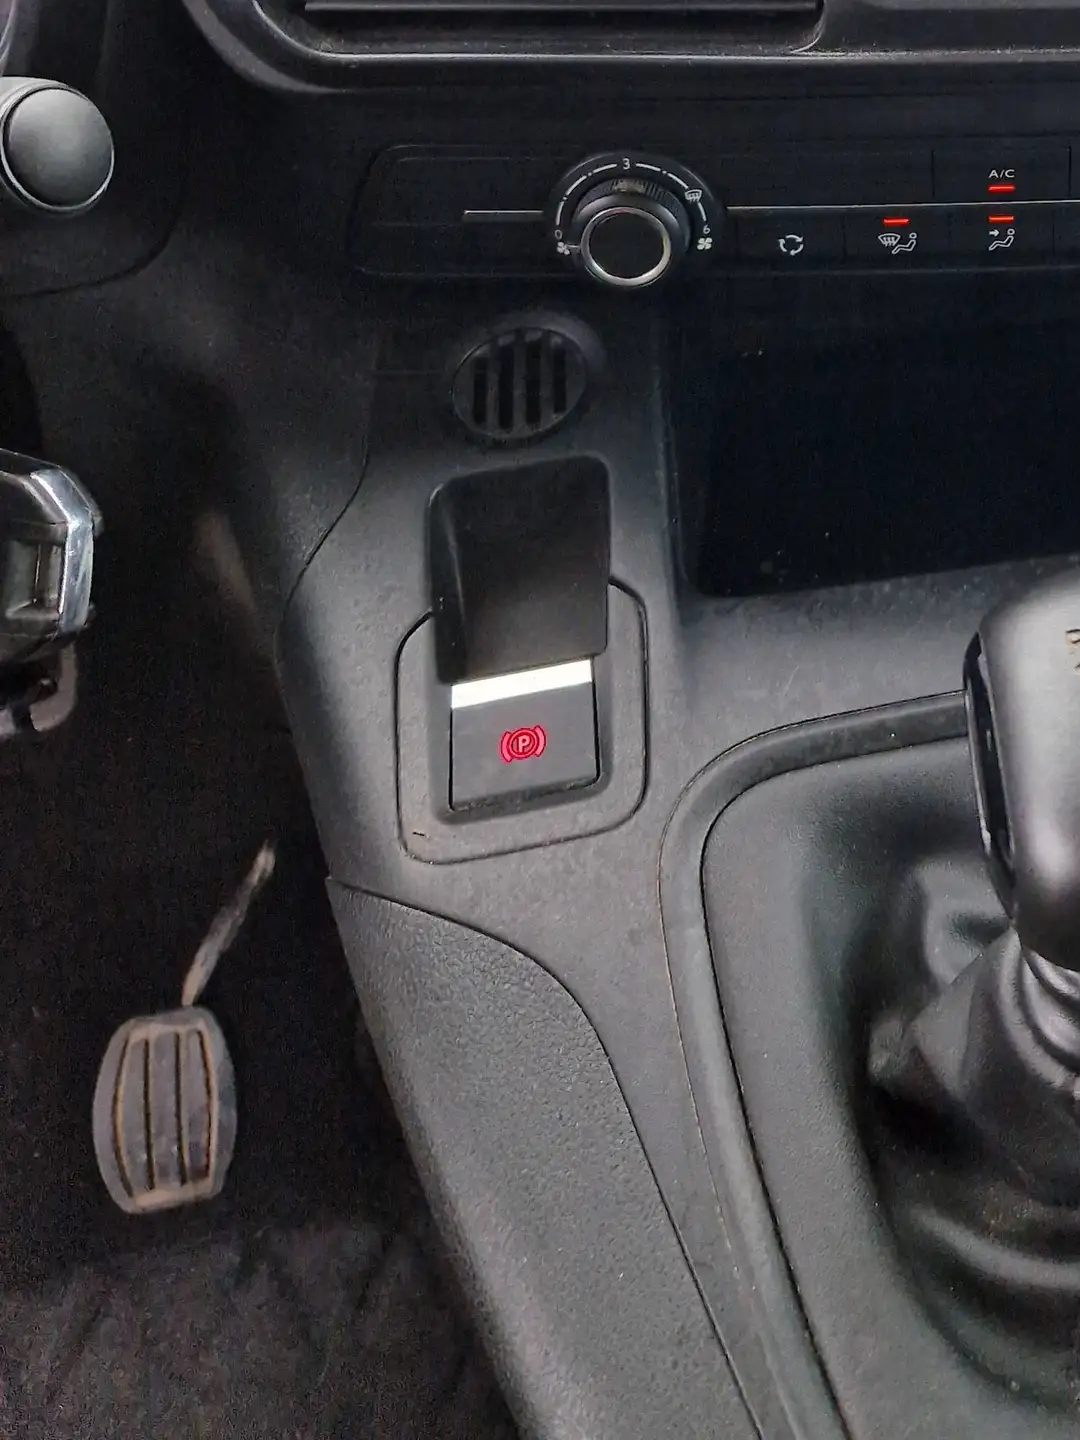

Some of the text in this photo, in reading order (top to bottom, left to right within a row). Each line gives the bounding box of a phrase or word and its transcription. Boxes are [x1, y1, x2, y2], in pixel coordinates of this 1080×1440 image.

[622, 158, 631, 170] 3
[988, 168, 1016, 179] A/C
[702, 224, 711, 235] 6
